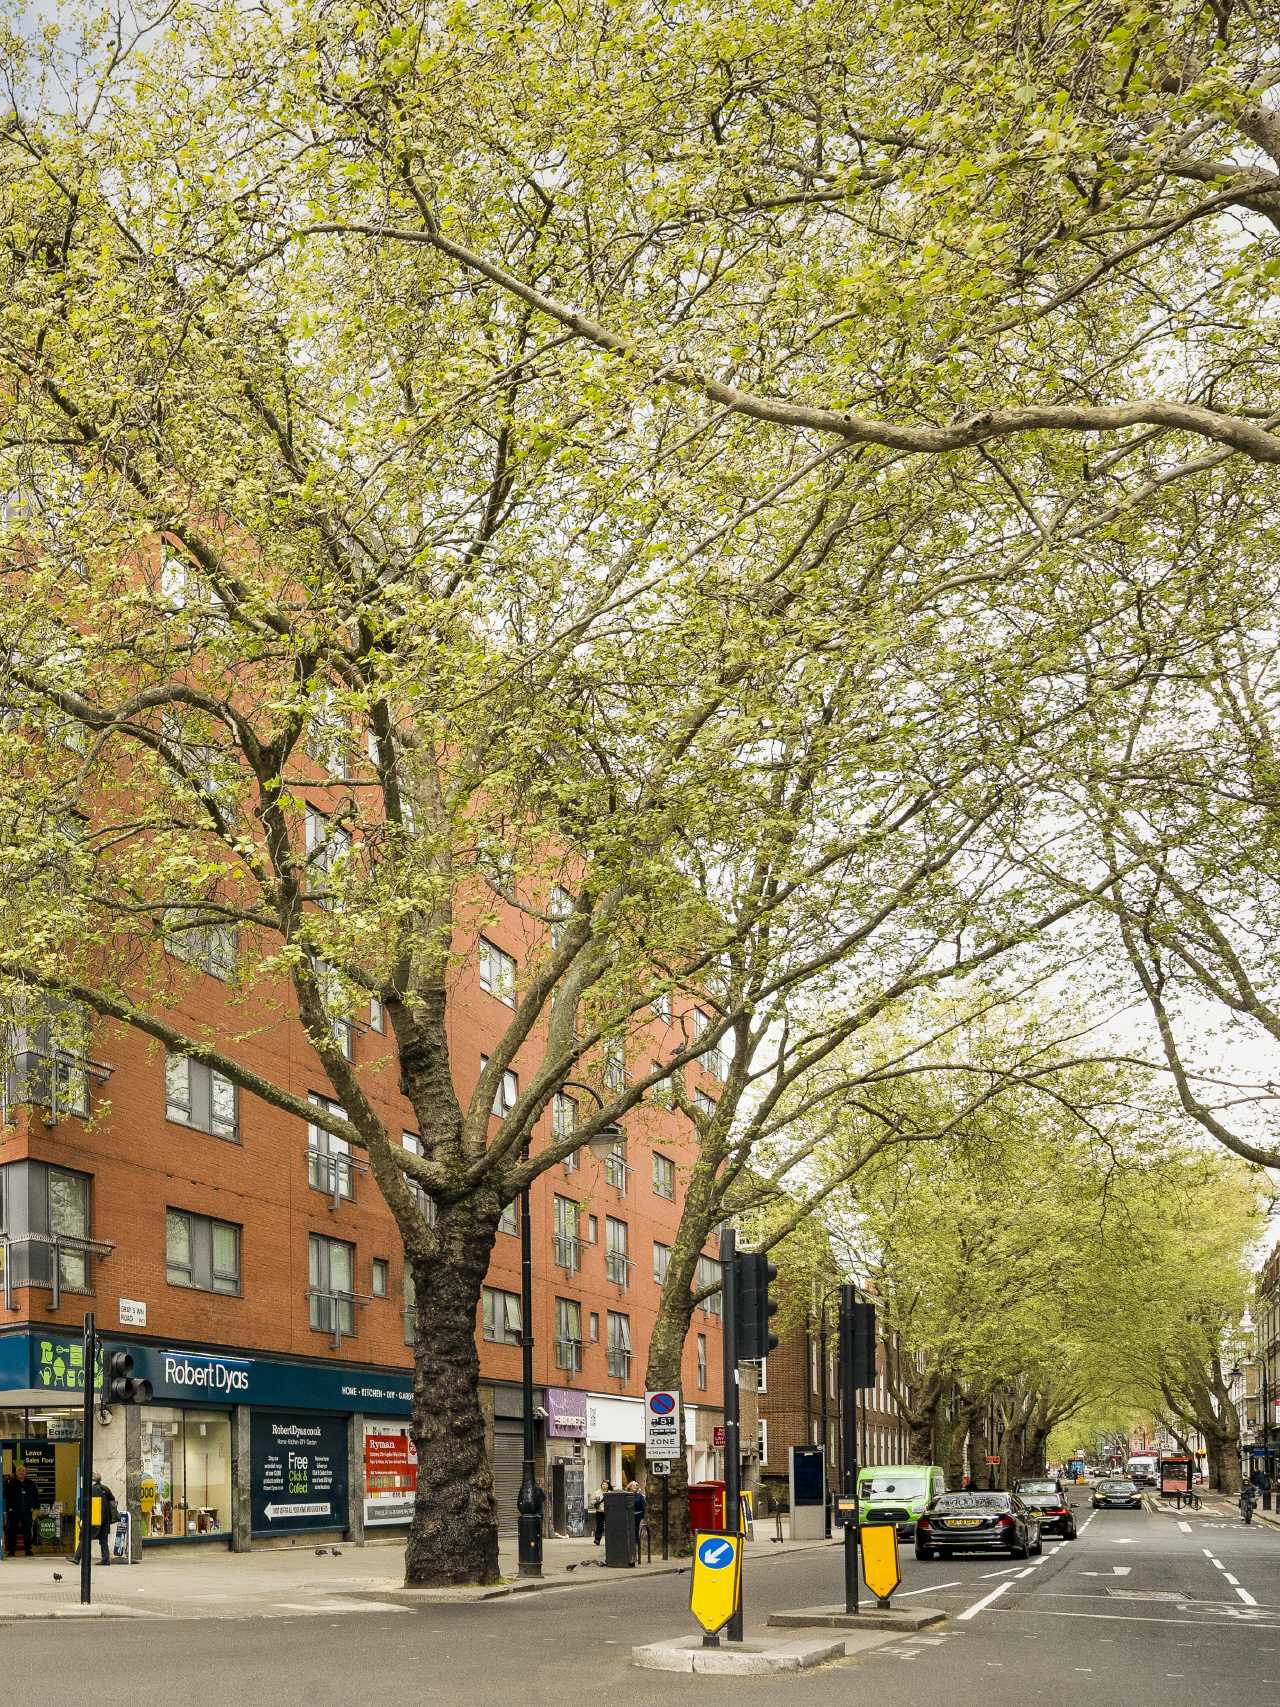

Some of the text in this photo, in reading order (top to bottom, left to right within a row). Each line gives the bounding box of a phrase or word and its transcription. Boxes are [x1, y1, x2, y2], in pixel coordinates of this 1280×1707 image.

[165, 1358, 249, 1393] Robert Dyas
[341, 1386, 357, 1396] HOME
[361, 1388, 383, 1398] KITCHEN
[386, 1390, 395, 1399] DIY
[369, 1440, 395, 1449] Ryman
[288, 1451, 308, 1470] Free
[288, 1470, 302, 1482] Click
